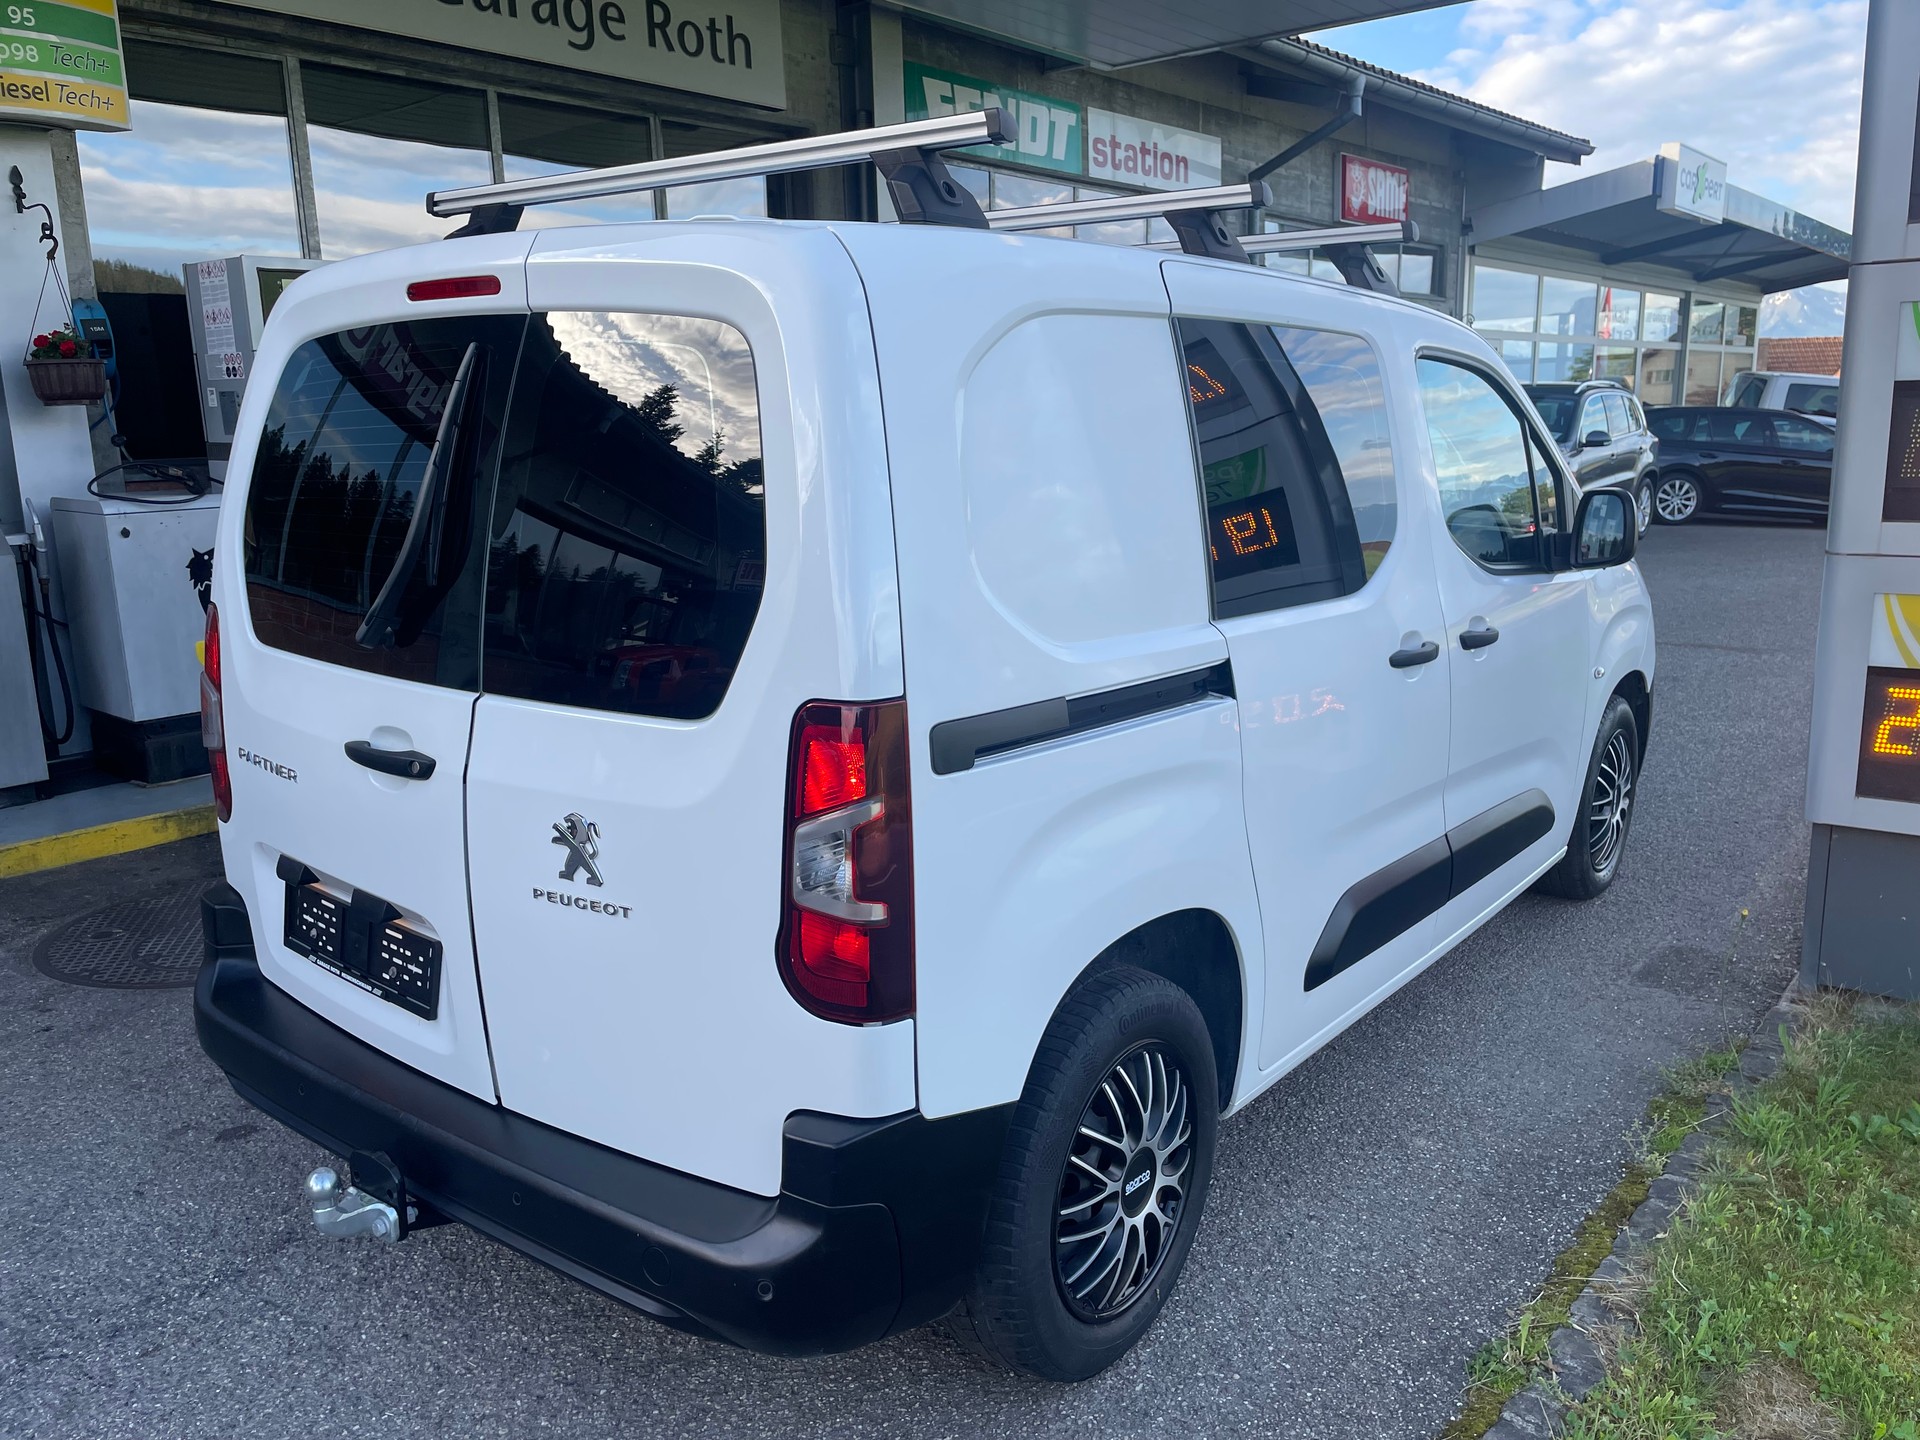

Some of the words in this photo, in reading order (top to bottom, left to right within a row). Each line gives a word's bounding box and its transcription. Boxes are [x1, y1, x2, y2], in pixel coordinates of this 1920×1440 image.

[7, 5, 36, 27] 95
[436, 0, 626, 51] age
[649, 0, 752, 69] Roth
[49, 44, 110, 74] Tech+
[54, 83, 115, 111] Tech+
[1092, 134, 1189, 184] station
[1367, 166, 1408, 221] SAME
[238, 747, 299, 784] PARTNER
[532, 887, 633, 919] PEUGEOT
[1125, 1169, 1151, 1194] sparco
